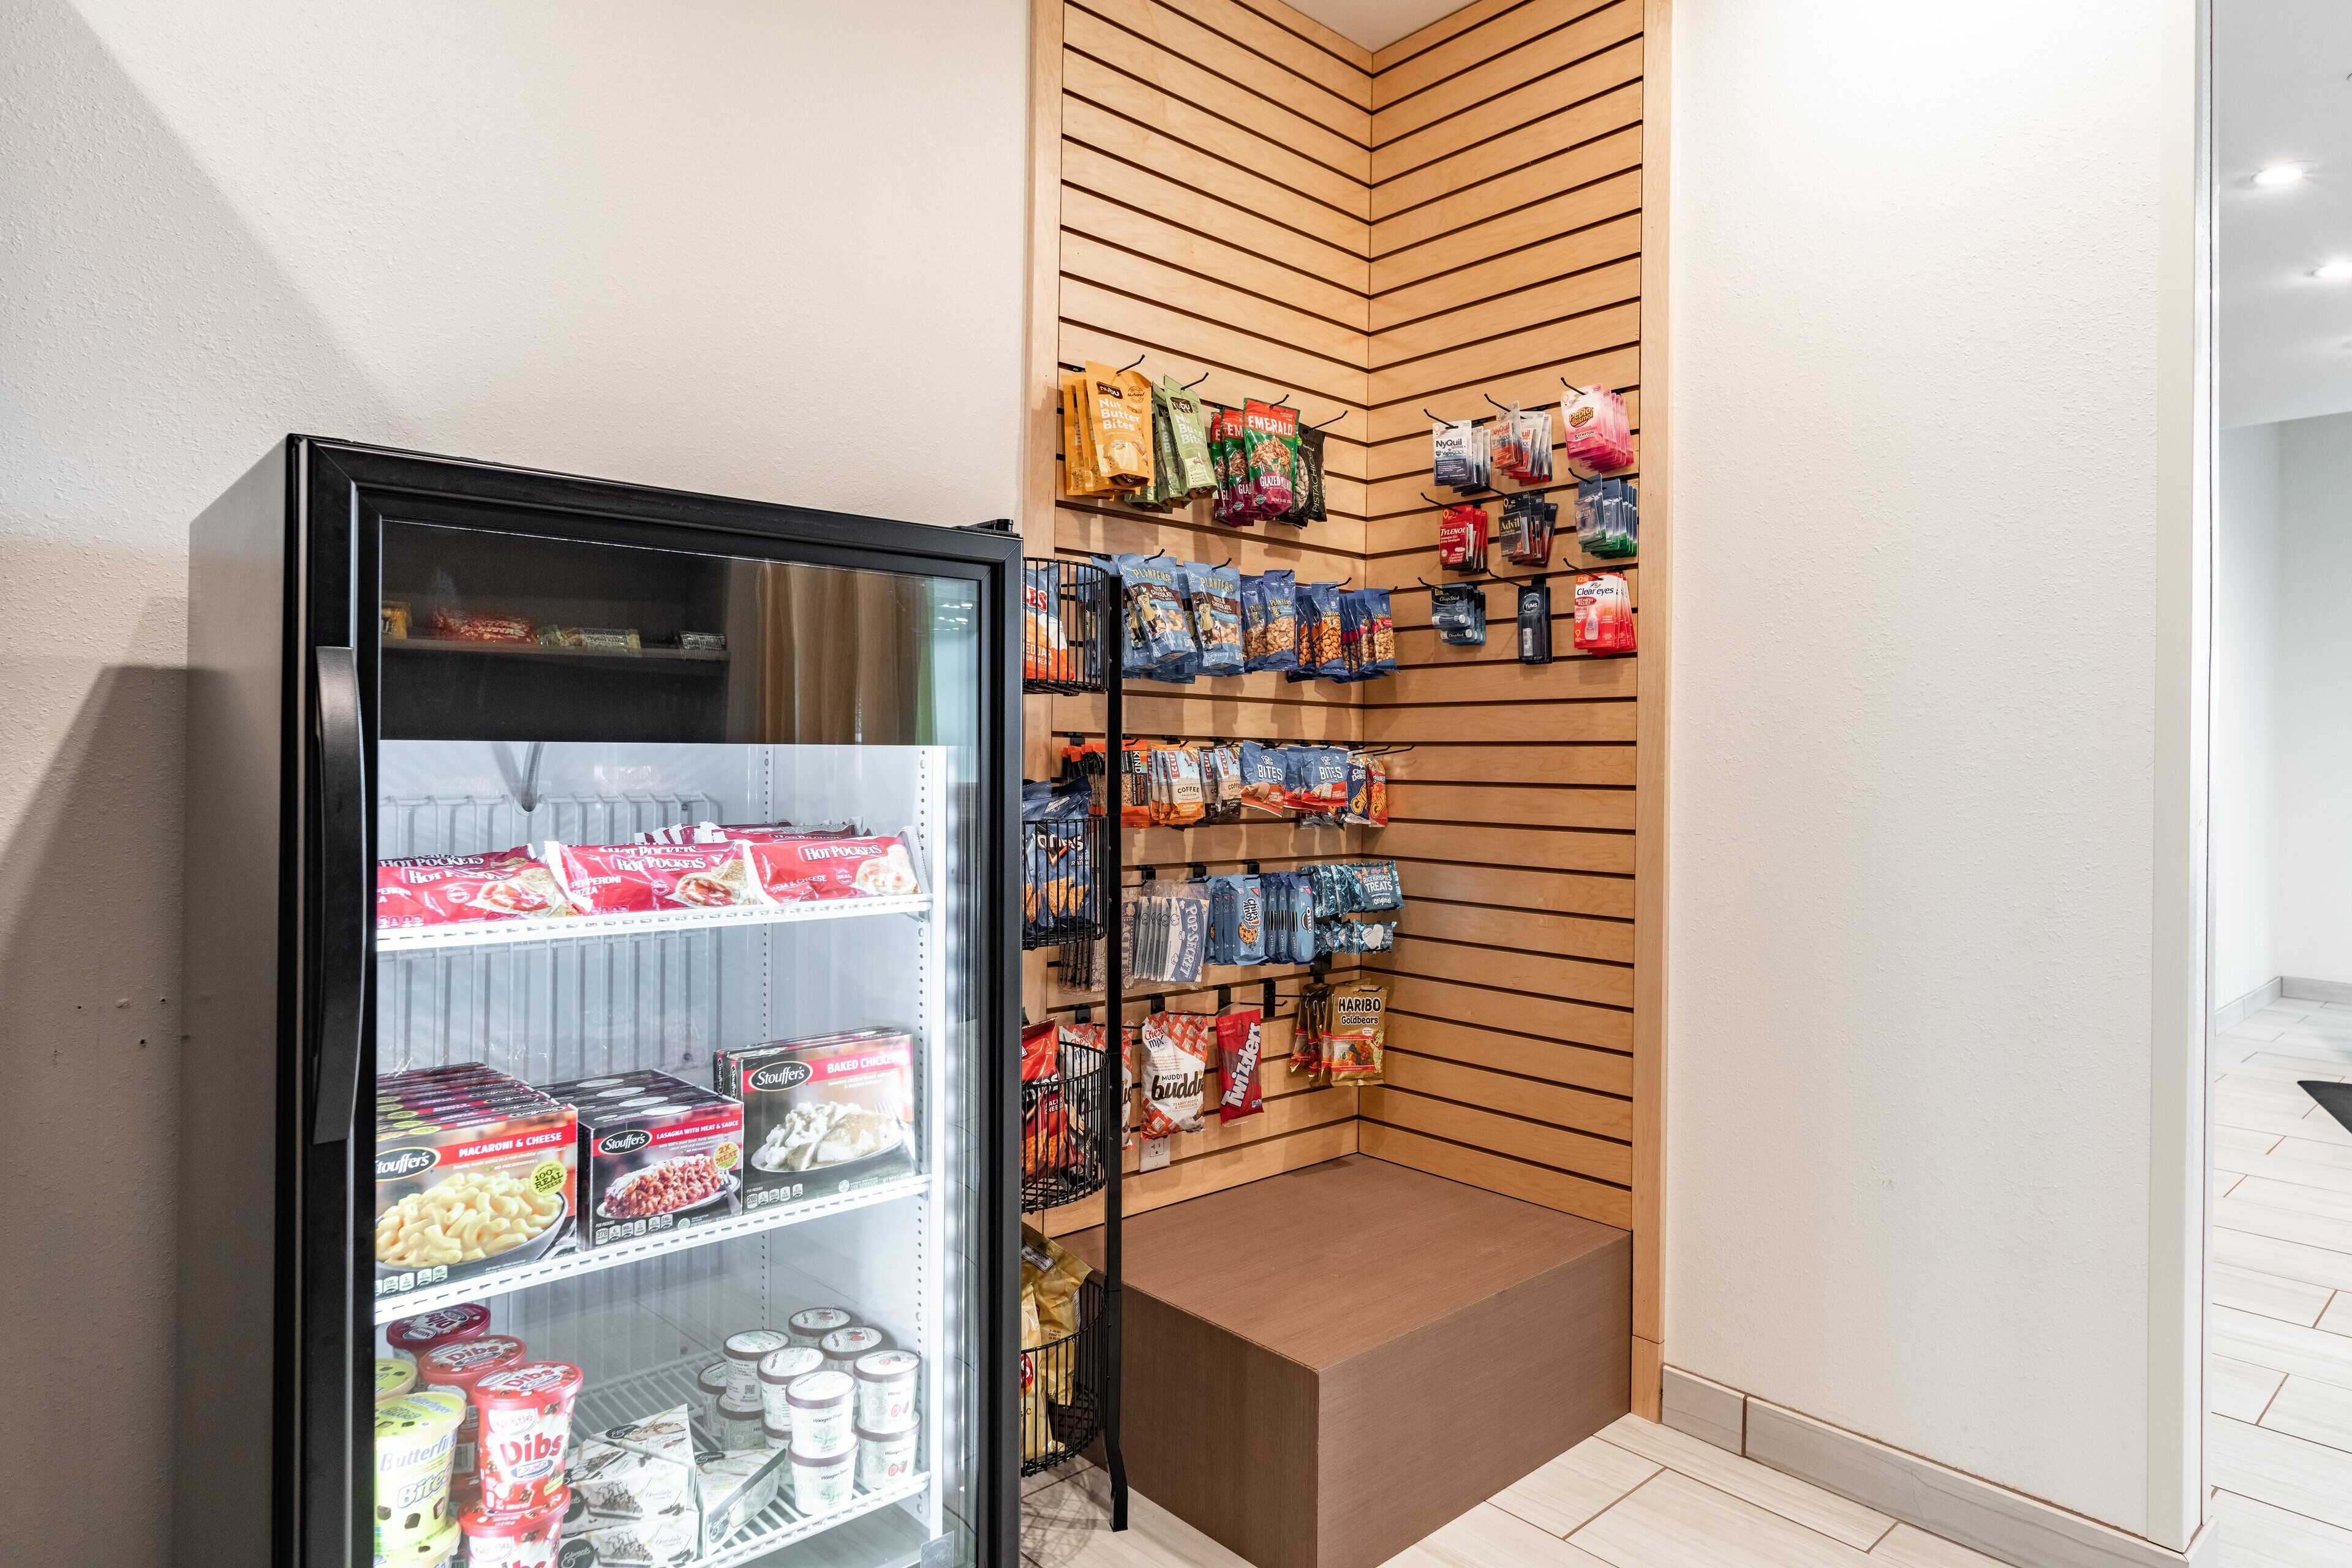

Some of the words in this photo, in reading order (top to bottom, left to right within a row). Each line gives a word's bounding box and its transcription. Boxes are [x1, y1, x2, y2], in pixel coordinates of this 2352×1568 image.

[1100, 386, 1120, 396] nubu
[1098, 398, 1123, 410] Nut
[1101, 408, 1140, 423] Butter
[1573, 413, 1593, 426] Bismol
[1103, 418, 1136, 431] Bites
[1248, 416, 1293, 436] EMERALD
[1436, 439, 1462, 448] NyQuil
[1260, 475, 1281, 488] GLAZED
[1309, 451, 1319, 513] PISTACHIOS
[1576, 509, 1591, 519] Claritin
[1501, 518, 1521, 530] Advil
[1440, 527, 1466, 537] TYLENOL
[1133, 569, 1171, 583] PLANTERS
[1200, 577, 1234, 595] PLANTERS
[1212, 601, 1232, 611] CHOCOLATE
[1133, 751, 1142, 774] KIND
[1168, 752, 1178, 771] CLIF
[1257, 764, 1283, 781] BITES
[1319, 766, 1343, 780] BITES
[804, 848, 830, 861] HOT
[830, 845, 883, 858] POCKETS
[417, 856, 484, 867] POCKETS
[617, 859, 644, 872] HOT
[645, 857, 706, 869] POCKETS
[408, 870, 443, 884] HOT
[571, 876, 621, 888] PEPPERONI
[796, 875, 827, 886] CHEESE
[1365, 881, 1393, 892] TREATS
[1338, 997, 1382, 1013] HARIBO
[1341, 1015, 1379, 1025] Goldbears
[1145, 1025, 1165, 1040] Chex
[1148, 1035, 1165, 1048] mix
[827, 1060, 859, 1074] BAKED
[860, 1054, 898, 1068] CHICKE
[757, 1066, 805, 1085] Stouffer's
[1152, 1071, 1204, 1101] buddi
[657, 1129, 683, 1139] LASAGNA
[459, 1140, 513, 1158] MACARONI
[516, 1139, 523, 1148] &
[526, 1132, 562, 1145] CHEESE
[605, 1134, 646, 1150] Stouffer's
[719, 1144, 730, 1153] 2X
[502, 1159, 538, 1168] PRESERVATIVES
[716, 1150, 737, 1164] MEAT
[534, 1172, 563, 1189] REAL
[535, 1167, 560, 1182] 100%
[539, 1179, 562, 1193] CHEESE
[446, 1346, 500, 1362] Dibs
[503, 1369, 554, 1387] Dibs
[500, 1431, 564, 1466] Dibs
